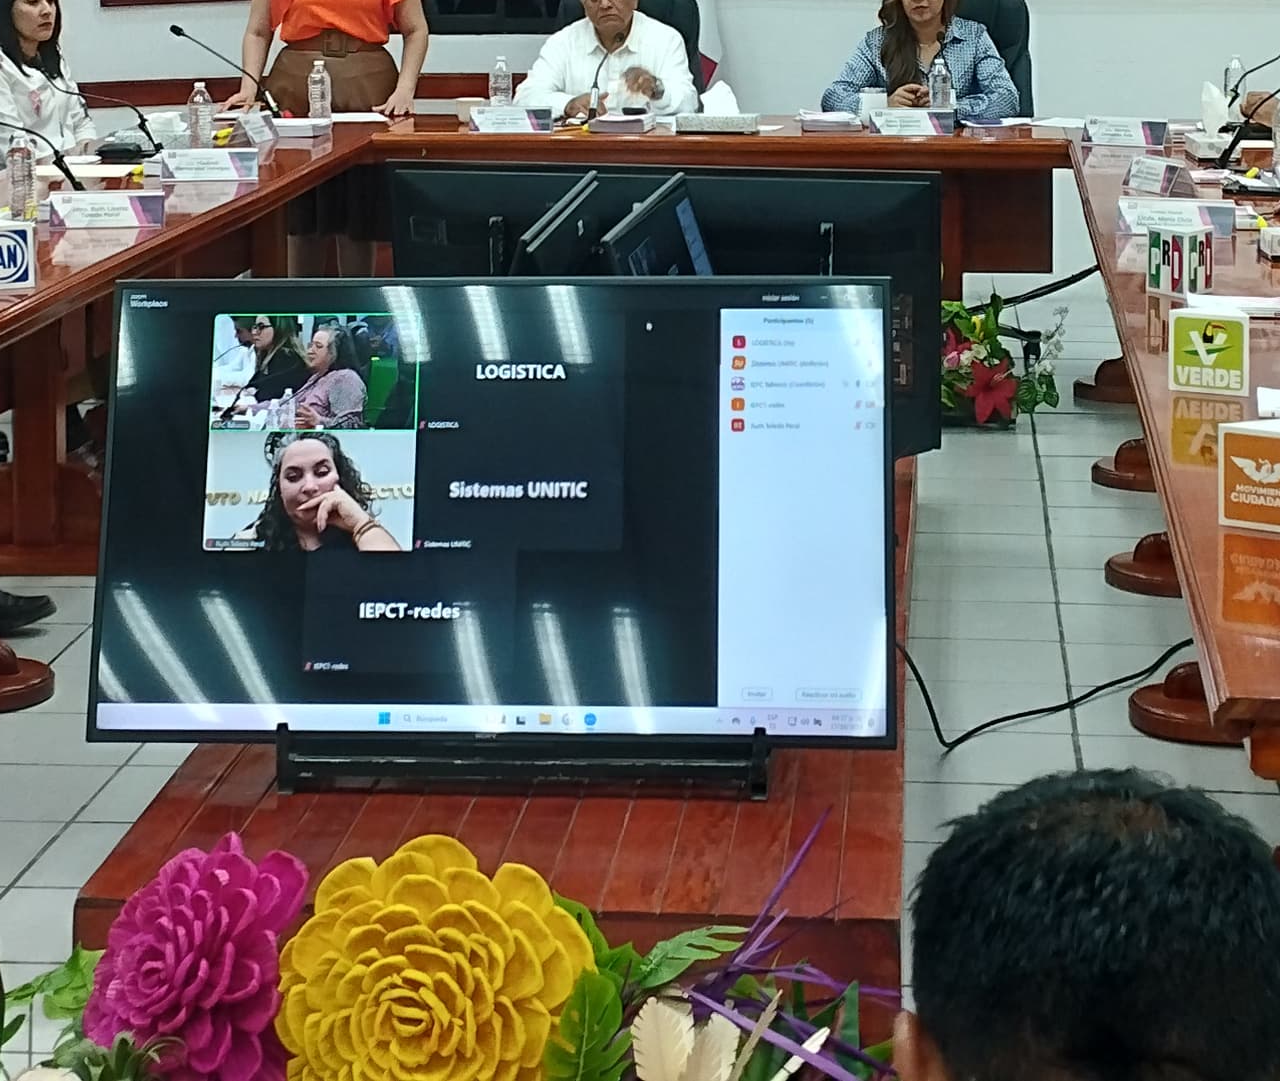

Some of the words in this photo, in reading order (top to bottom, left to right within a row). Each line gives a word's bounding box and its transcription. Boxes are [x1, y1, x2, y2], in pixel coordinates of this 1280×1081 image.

[1150, 238, 1181, 281] PRI
[1190, 239, 1212, 281] PRI
[475, 363, 566, 380] LOGISTICA
[1176, 365, 1242, 389] VERDE
[449, 481, 524, 498] Sistemas
[527, 481, 588, 498] UNITIC
[358, 602, 461, 620] IEPCT-redes
